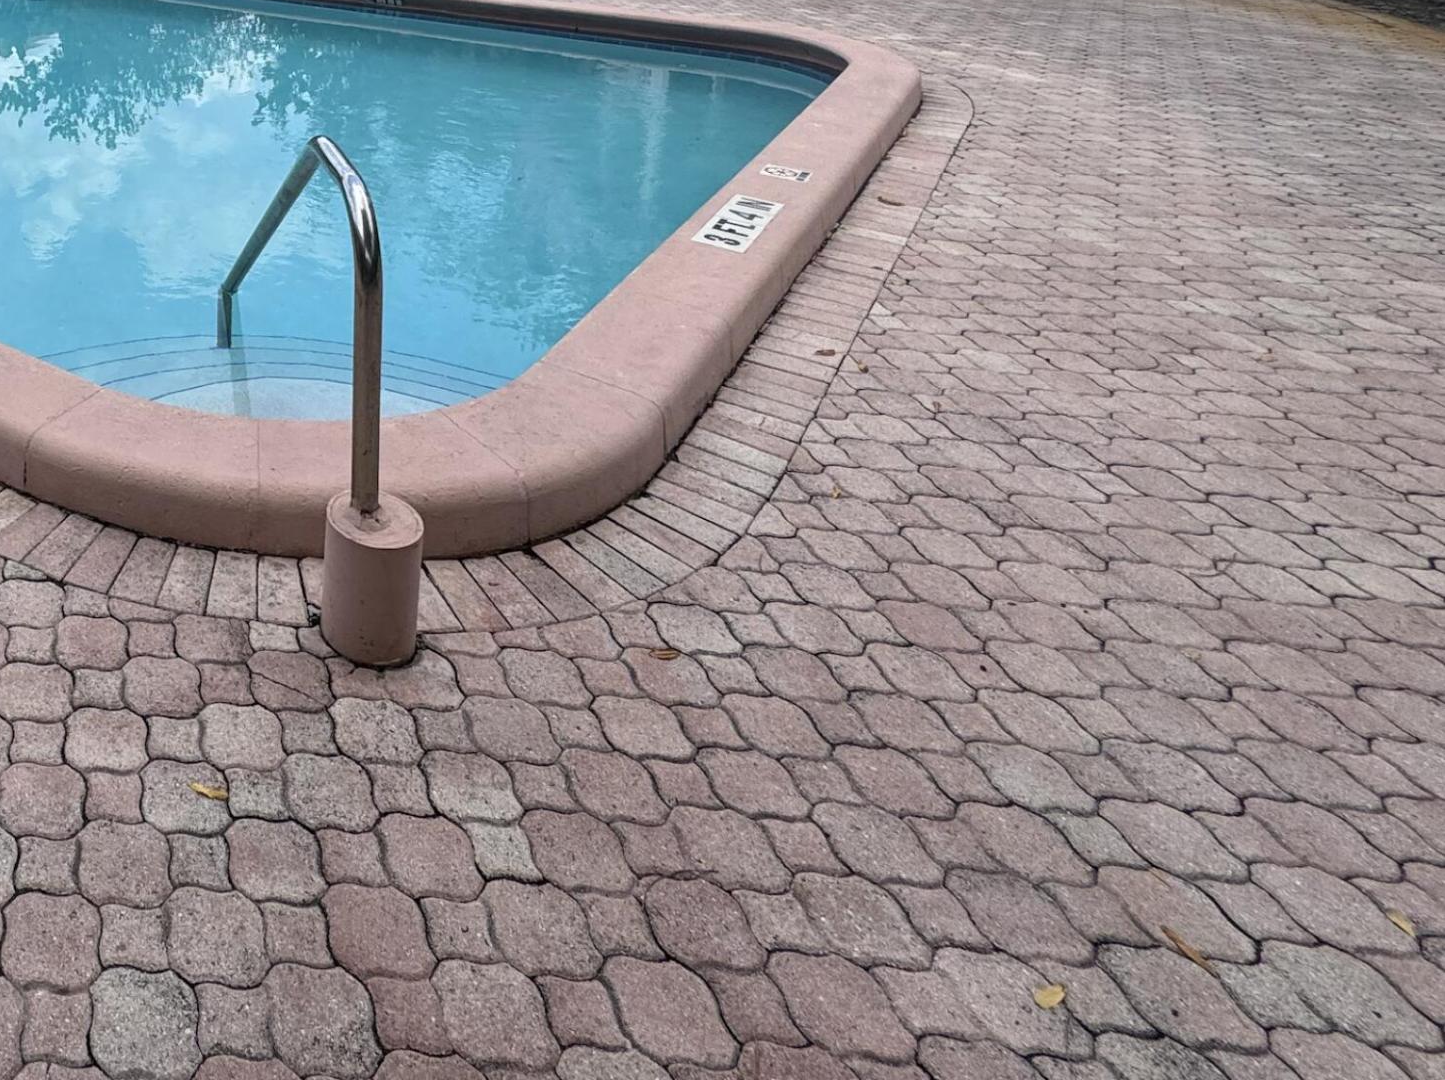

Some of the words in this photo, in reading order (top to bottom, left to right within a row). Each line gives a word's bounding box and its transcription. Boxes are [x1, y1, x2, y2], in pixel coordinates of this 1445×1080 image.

[735, 197, 775, 212] IN
[729, 209, 764, 221] 4
[703, 234, 741, 246] 3
